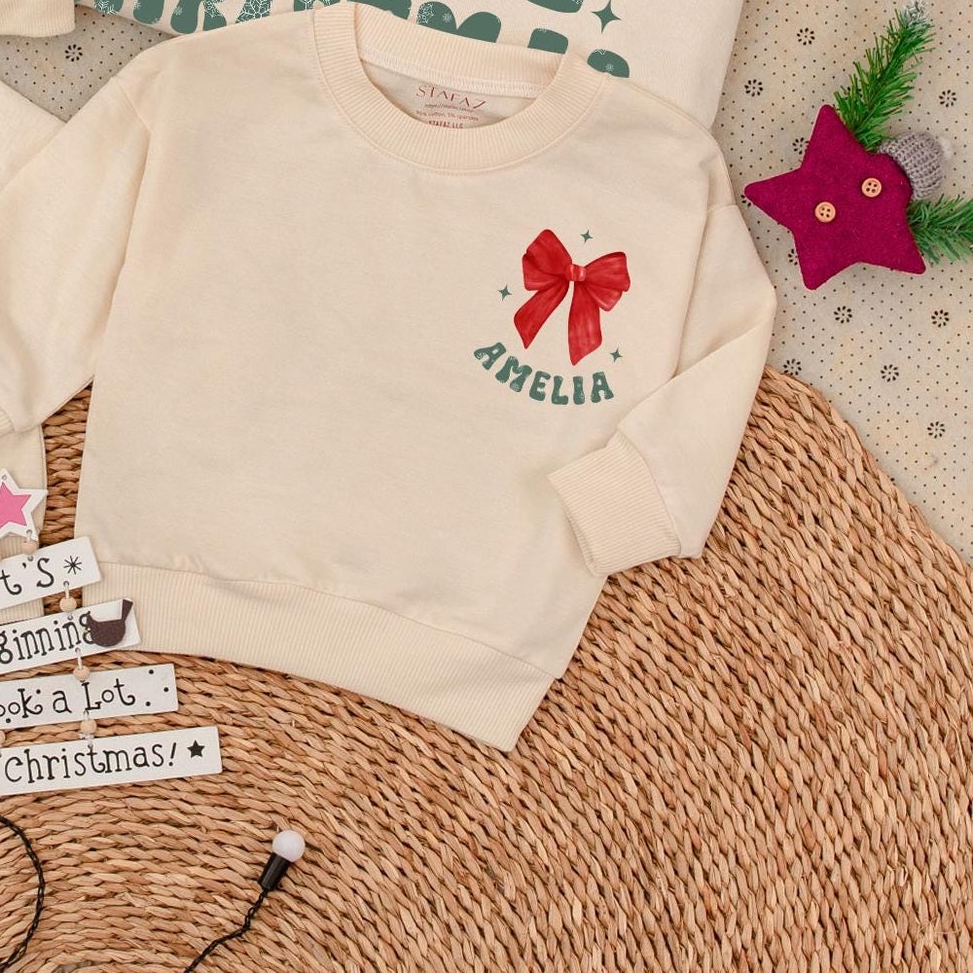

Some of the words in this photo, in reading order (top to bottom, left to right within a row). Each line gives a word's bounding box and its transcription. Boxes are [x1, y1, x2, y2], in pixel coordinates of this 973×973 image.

[473, 342, 614, 405] AMELIA
[52, 690, 72, 714] a
[81, 677, 136, 712] Lot
[4, 741, 177, 784] Christmas!
